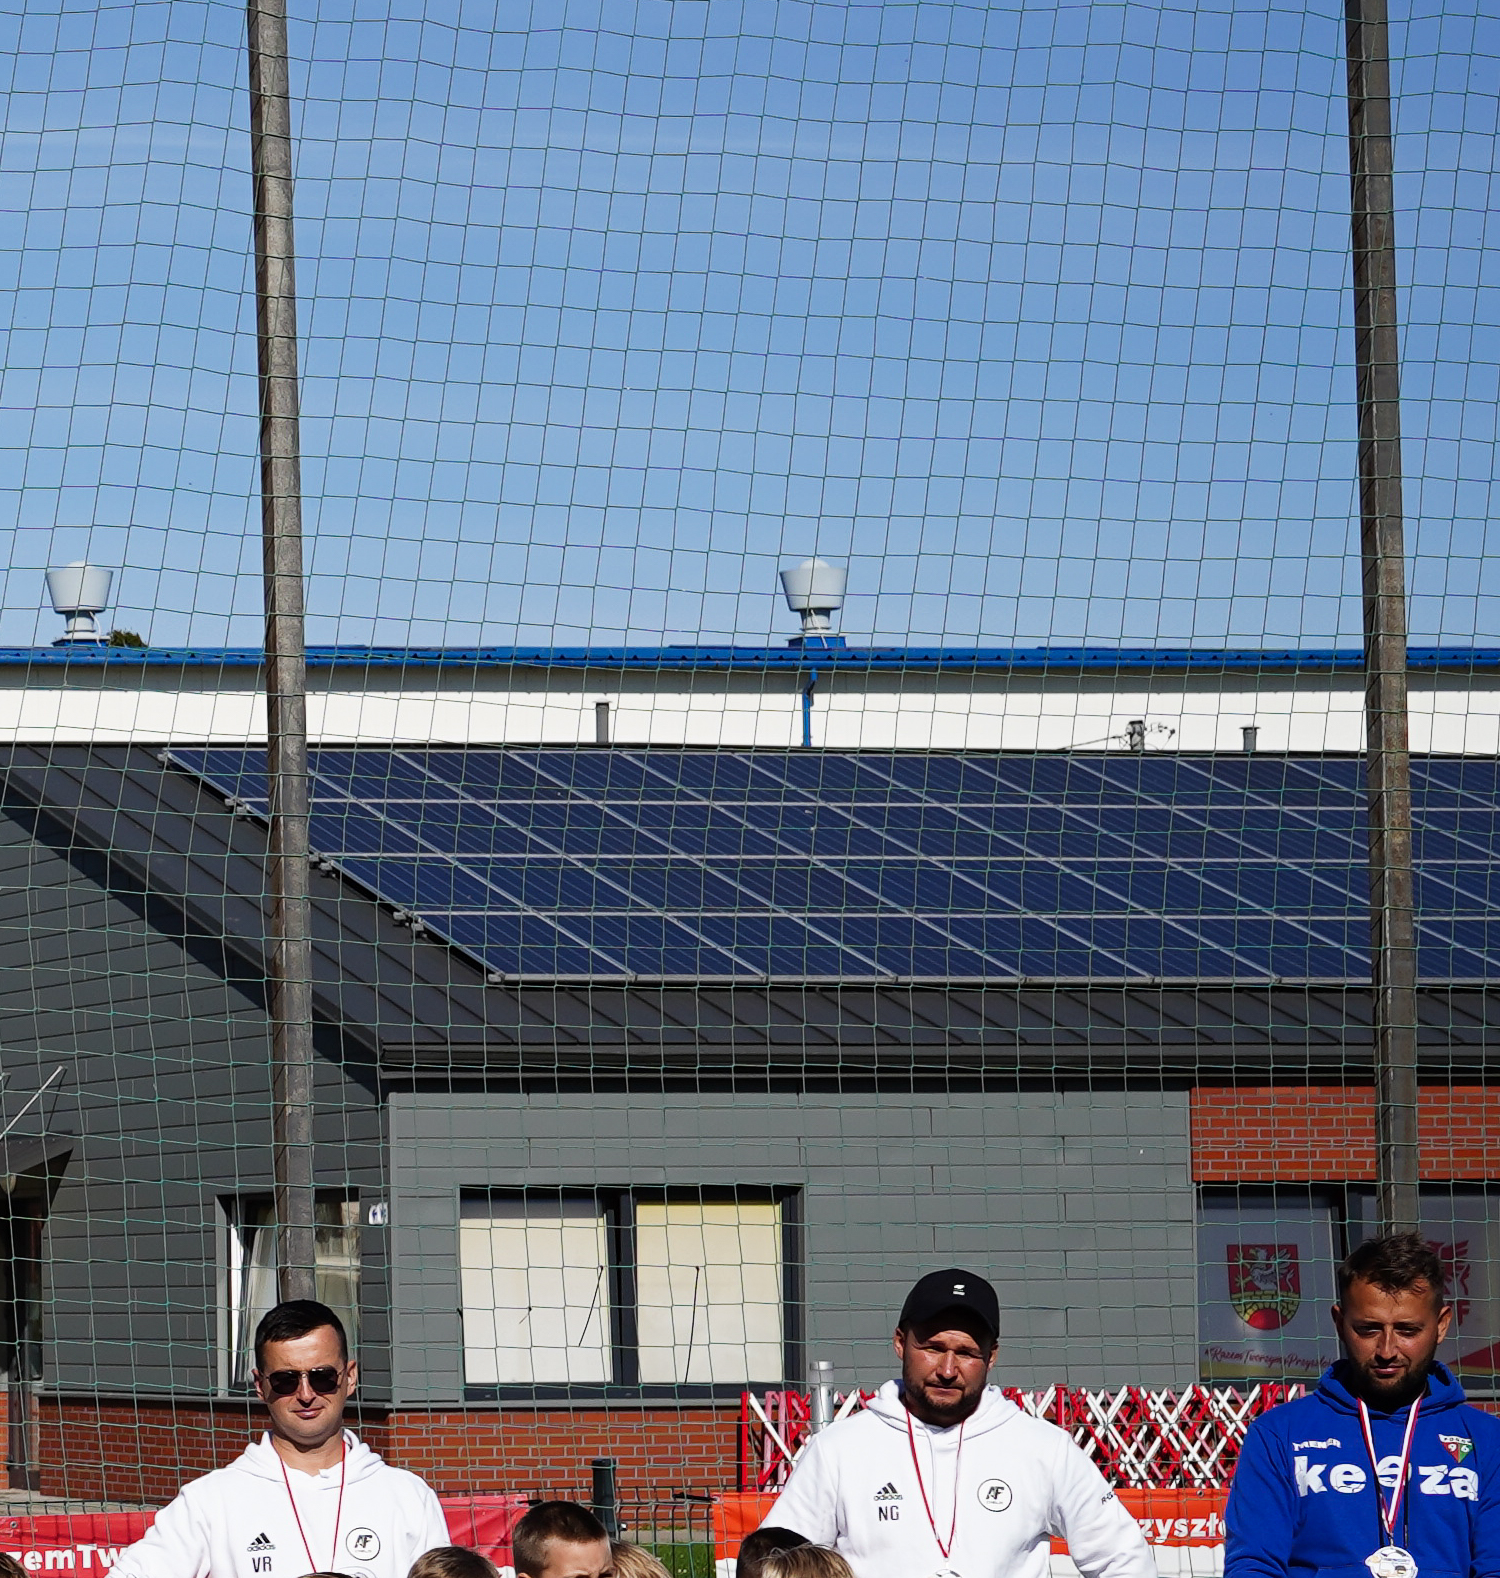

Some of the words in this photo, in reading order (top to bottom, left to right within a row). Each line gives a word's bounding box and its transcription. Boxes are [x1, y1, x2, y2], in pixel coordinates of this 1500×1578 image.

[1293, 1456, 1480, 1501] keeza
[878, 1505, 899, 1522] NG
[251, 1556, 273, 1574] VR
